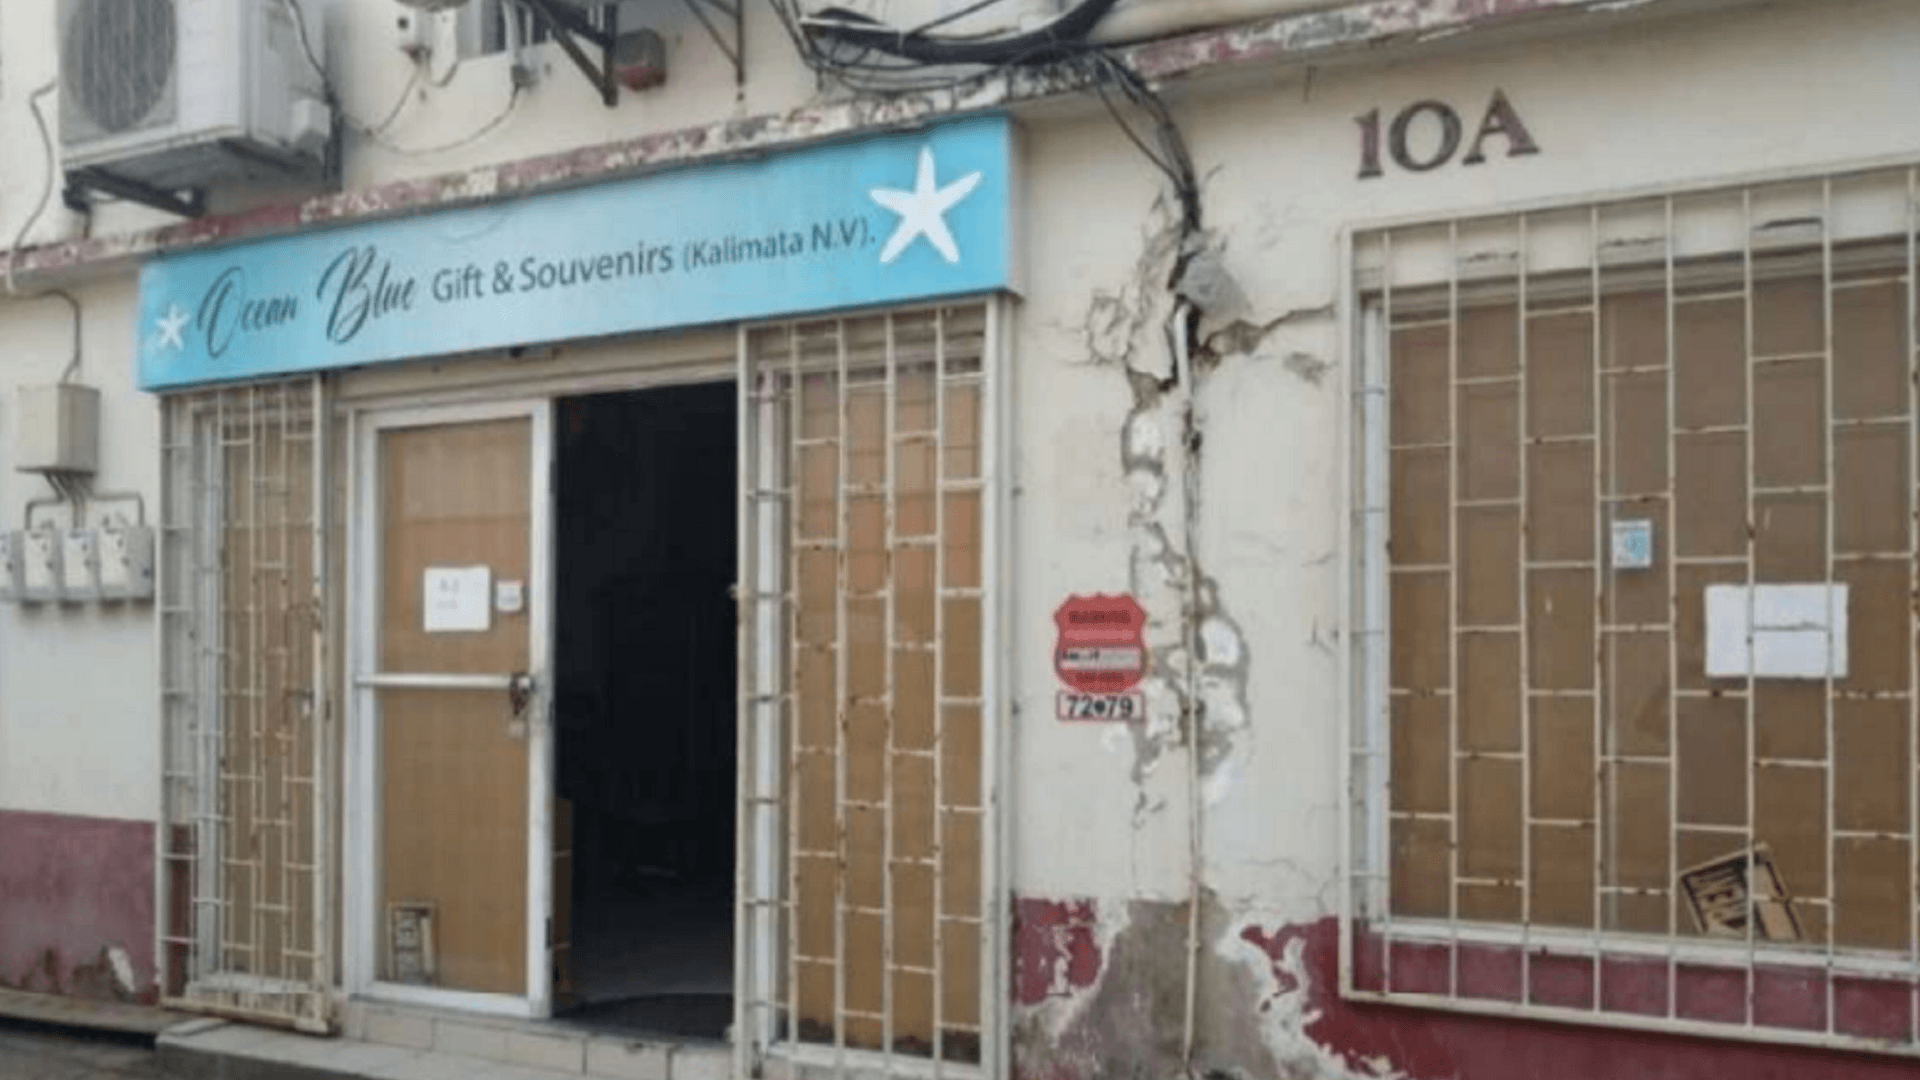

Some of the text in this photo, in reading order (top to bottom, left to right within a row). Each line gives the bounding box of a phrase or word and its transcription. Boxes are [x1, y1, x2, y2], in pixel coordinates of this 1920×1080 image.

[197, 266, 299, 358] Ocean
[316, 244, 416, 345] Blue
[432, 265, 484, 304] Gift
[491, 262, 515, 294] &
[519, 241, 675, 292] Souvenirs
[682, 230, 806, 273] (Kalimata
